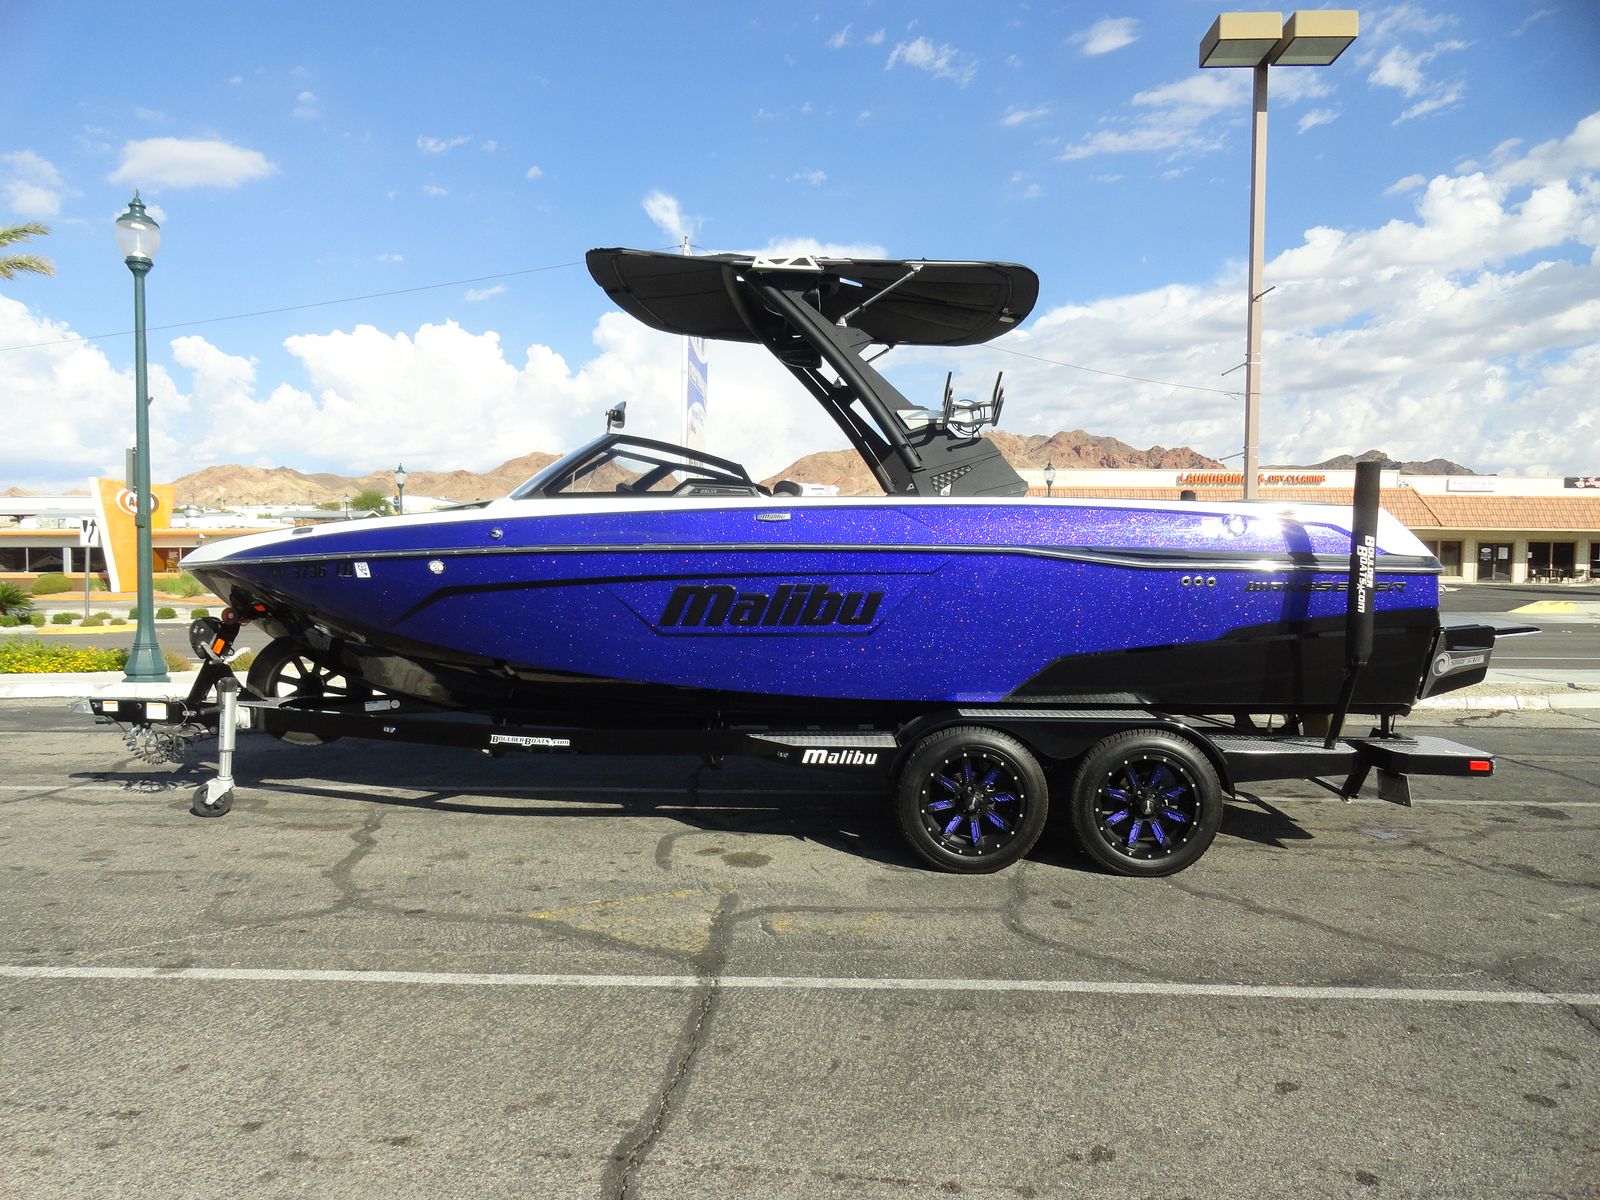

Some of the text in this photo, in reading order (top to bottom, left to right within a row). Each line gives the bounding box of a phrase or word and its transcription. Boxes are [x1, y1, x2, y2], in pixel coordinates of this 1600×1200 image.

[1180, 472, 1245, 484] LAUNDROM
[1365, 535, 1375, 588] BOULDER
[658, 583, 885, 627] Malibu
[801, 749, 878, 765] Malibu
